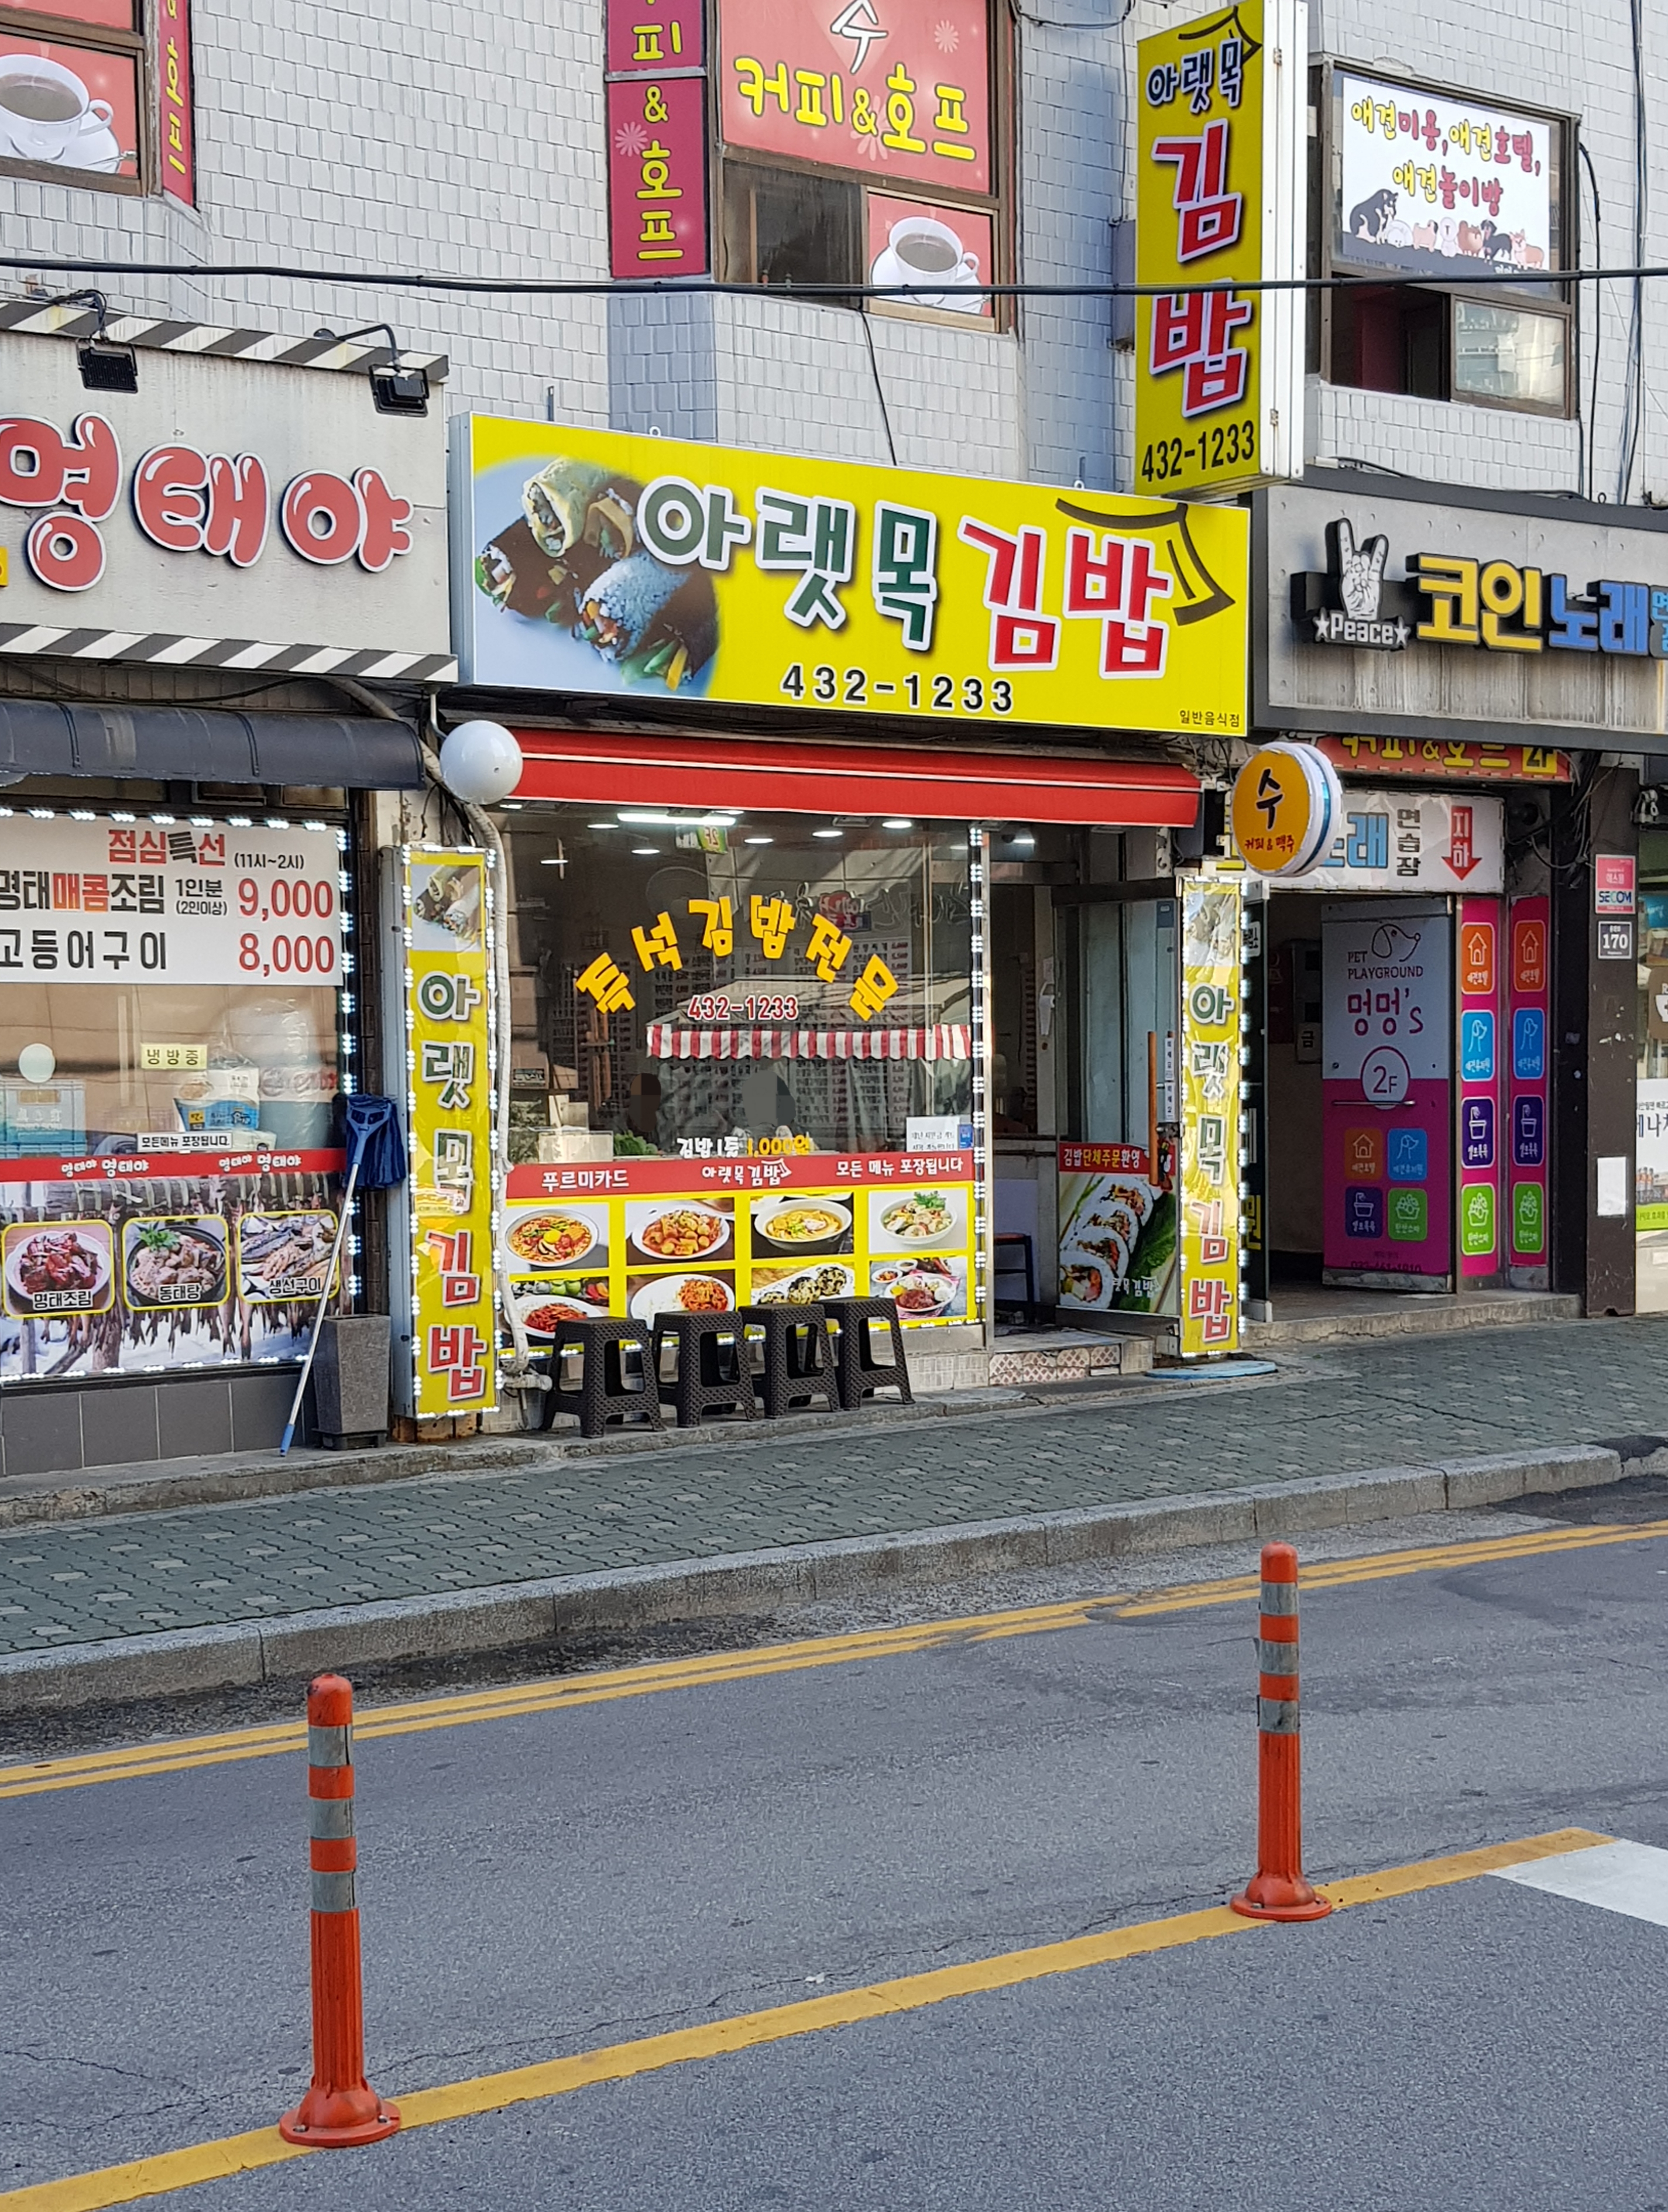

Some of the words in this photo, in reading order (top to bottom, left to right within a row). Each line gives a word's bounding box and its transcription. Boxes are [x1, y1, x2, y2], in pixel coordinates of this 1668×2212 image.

[830, 0, 888, 74] 수
[1145, 37, 1243, 114] 아랫목
[733, 56, 977, 161] 커피&호프
[1393, 160, 1504, 217] 애견놀이방
[1150, 117, 1252, 418] 김밥
[1141, 419, 1255, 483] 432-1233
[0, 411, 414, 592] 명태야
[637, 475, 937, 652] 아랫목
[957, 514, 1175, 679] 김밥
[1330, 612, 1395, 643] Peace
[781, 665, 1013, 713] 432-1233
[1179, 709, 1241, 729] 일반음식점
[1255, 768, 1284, 830] 수
[108, 829, 226, 867] 점심특선
[234, 852, 305, 870] (11시~2시)
[1244, 837, 1264, 850] 커피
[1275, 834, 1295, 853] 맥주
[1396, 809, 1422, 877] 연습장
[1453, 812, 1470, 868] 지하
[0, 870, 165, 915] 명태매콤조림
[175, 878, 224, 898] 1인분
[238, 877, 334, 922] 9,000
[176, 901, 228, 916] (2인이상)
[1598, 890, 1632, 904] SECOM
[0, 929, 167, 971] 고등어구이
[238, 933, 335, 977] 8,000
[1602, 933, 1629, 950] 170
[1347, 951, 1368, 964] PET
[1347, 966, 1424, 980] PLAYGROUND
[687, 995, 799, 1021] 432-1233
[1372, 1065, 1398, 1094] 2F
[677, 1137, 713, 1159] 김밥
[747, 1134, 810, 1158] 1,000원
[61, 1159, 98, 1179] 명태야
[101, 1157, 150, 1178] 명태야
[218, 1153, 253, 1172] 명태야
[256, 1153, 303, 1173] 명태야
[702, 1165, 744, 1185] 아랫목
[747, 1164, 781, 1186] 김밥
[836, 1160, 863, 1178] 모든
[868, 1160, 895, 1176] 메뉴
[899, 1156, 964, 1176] 포장됩니다
[541, 1169, 629, 1192] 푸르미카드
[157, 1283, 201, 1302] 동태탕
[267, 1276, 323, 1295] 생선구이
[32, 1289, 93, 1312] 명태조림
